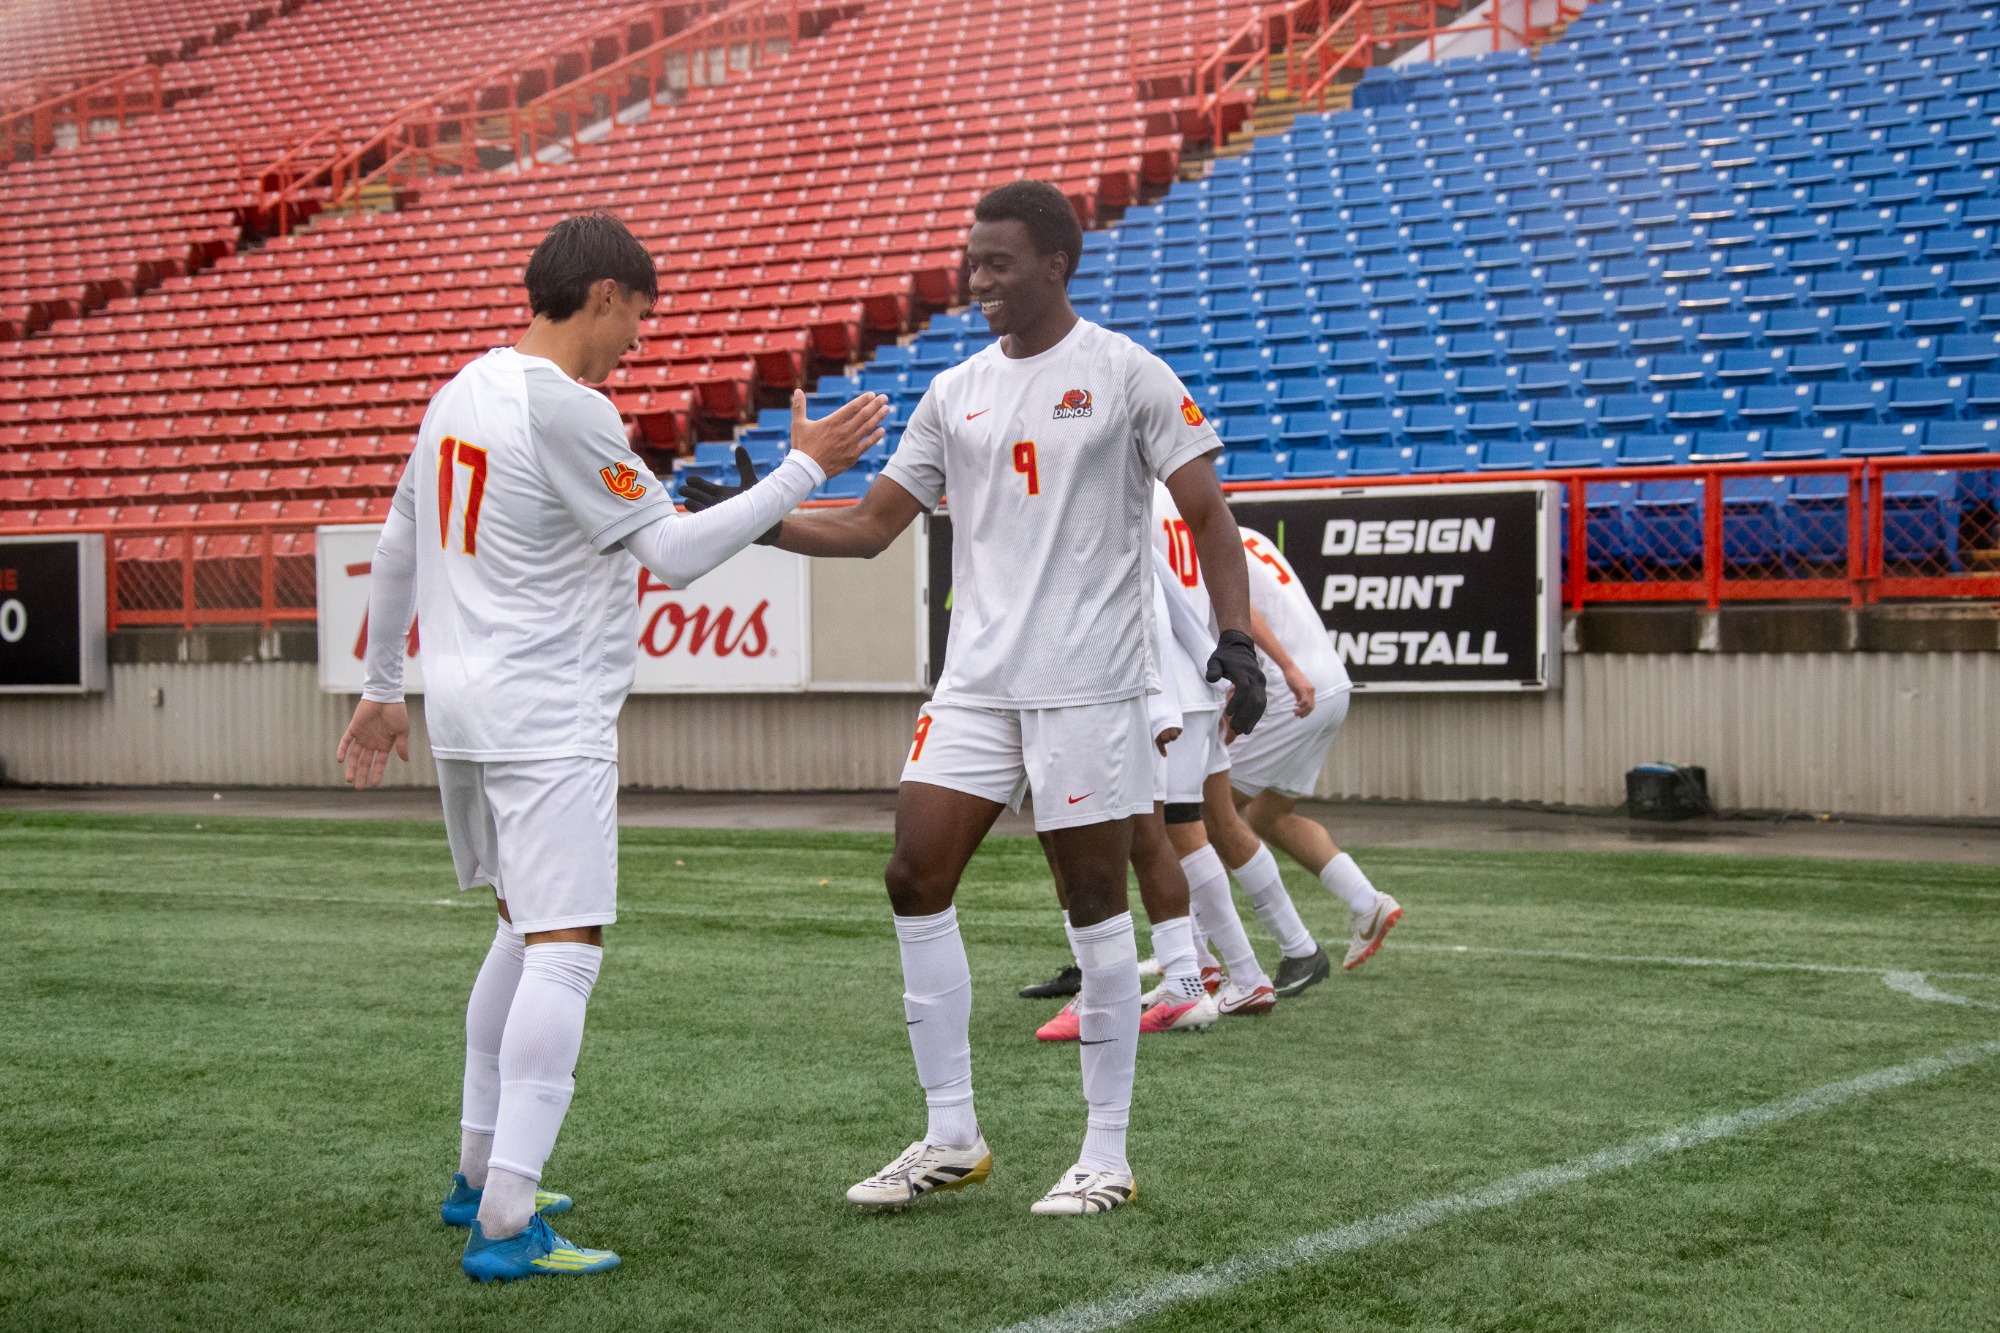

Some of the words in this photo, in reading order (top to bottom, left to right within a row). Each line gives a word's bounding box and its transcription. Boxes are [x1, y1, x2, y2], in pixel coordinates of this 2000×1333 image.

[1053, 406, 1093, 420] DINOS
[1012, 440, 1041, 496] 9
[437, 435, 489, 557] 17
[1163, 518, 1199, 588] 10
[1321, 517, 1496, 556] DESIGN
[1321, 574, 1465, 611] PRINT
[911, 714, 933, 762] 9
